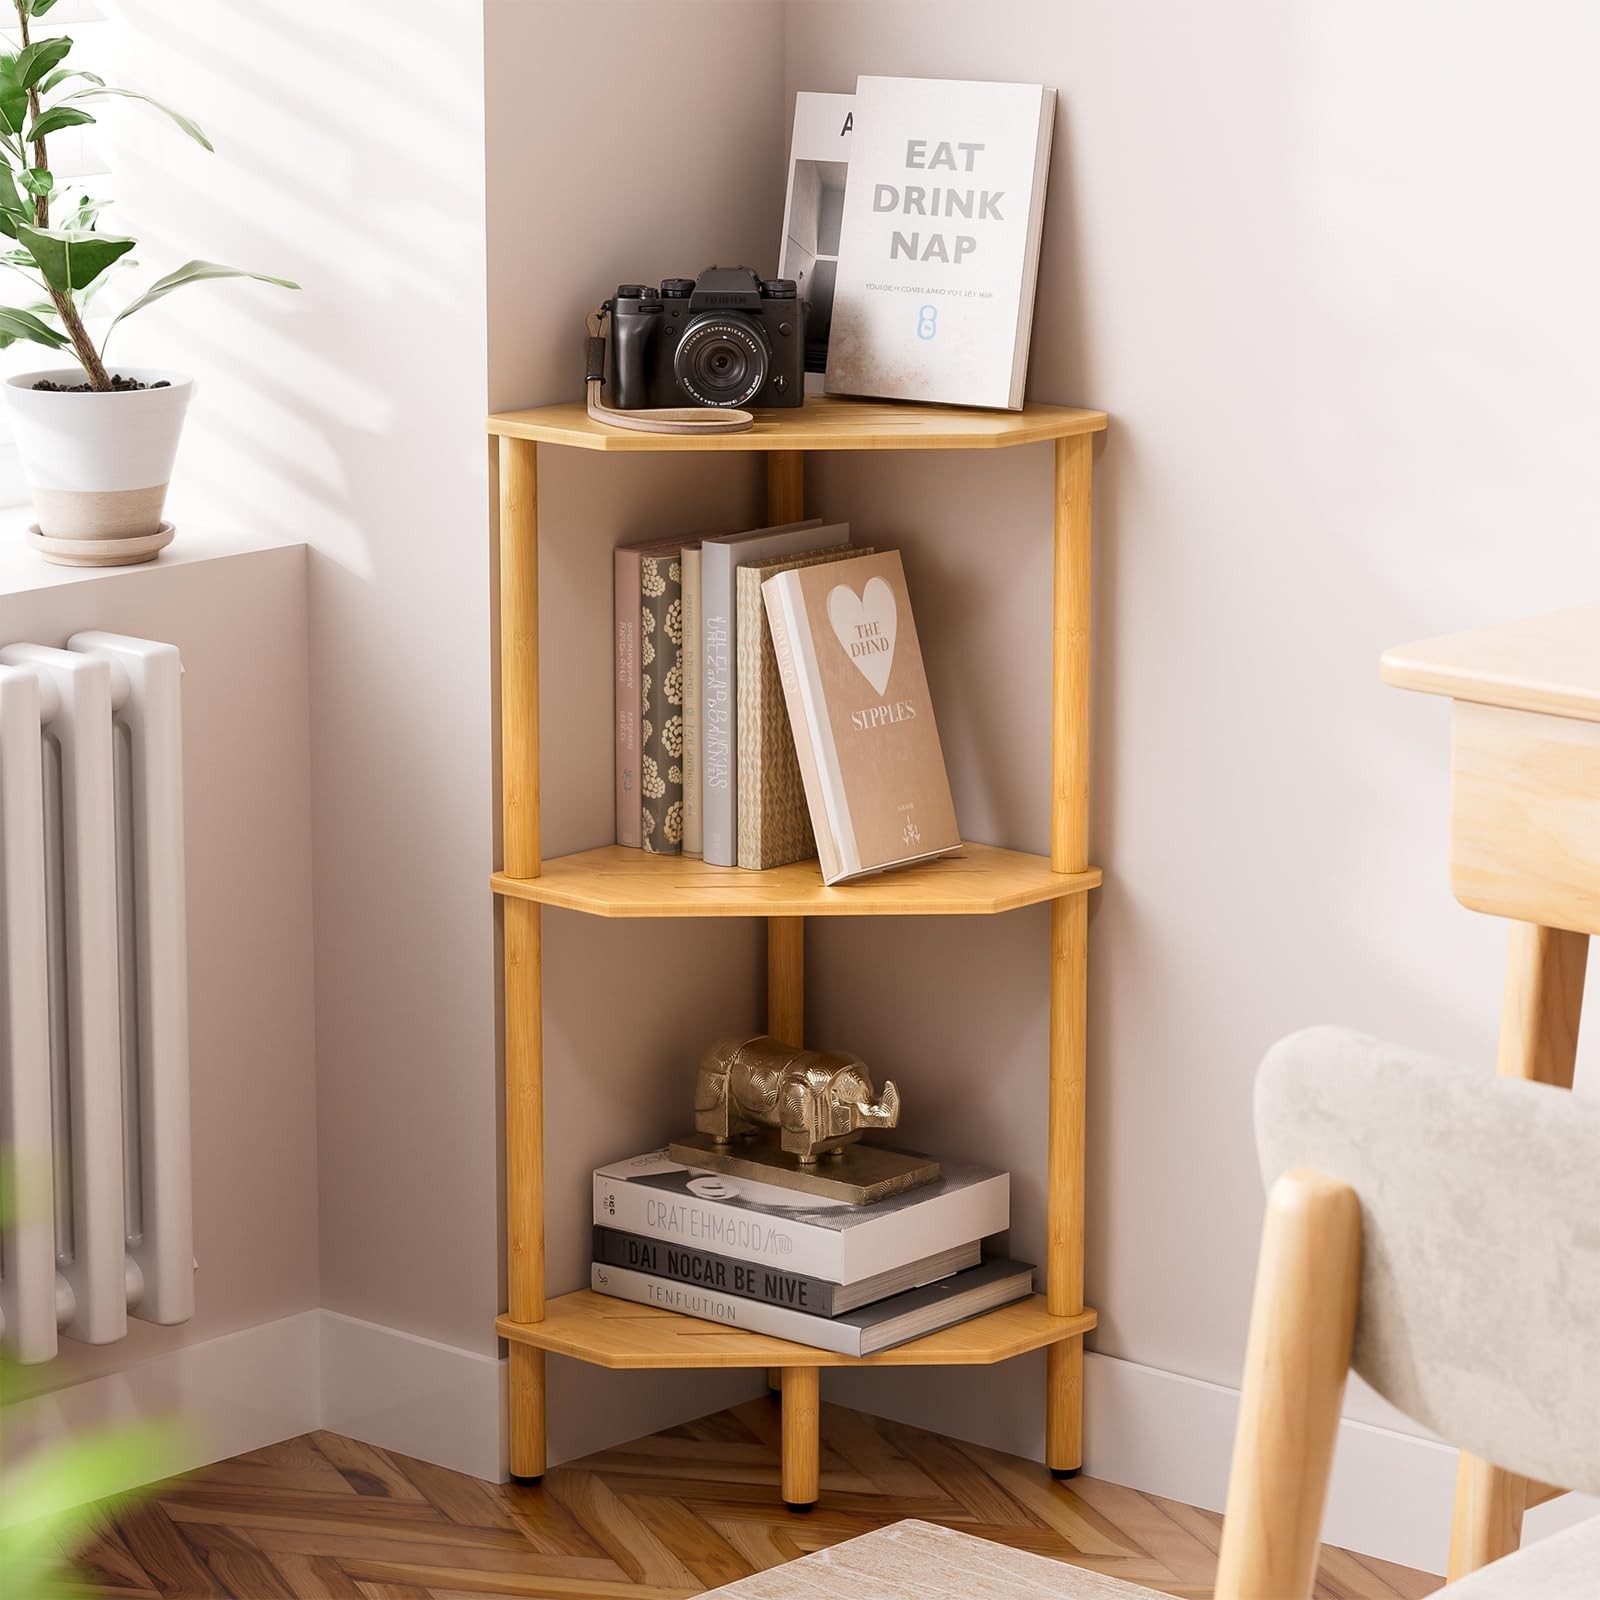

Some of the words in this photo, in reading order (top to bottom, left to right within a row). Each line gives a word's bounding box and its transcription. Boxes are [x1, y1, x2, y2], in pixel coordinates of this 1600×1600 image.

[905, 139, 985, 172] EAT
[872, 183, 1006, 221] DRINK
[889, 231, 977, 264] NAP
[855, 621, 881, 639] THE
[667, 1250, 727, 1288] NOCAR
[734, 1265, 756, 1294] BE
[764, 1273, 808, 1308] NIVE
